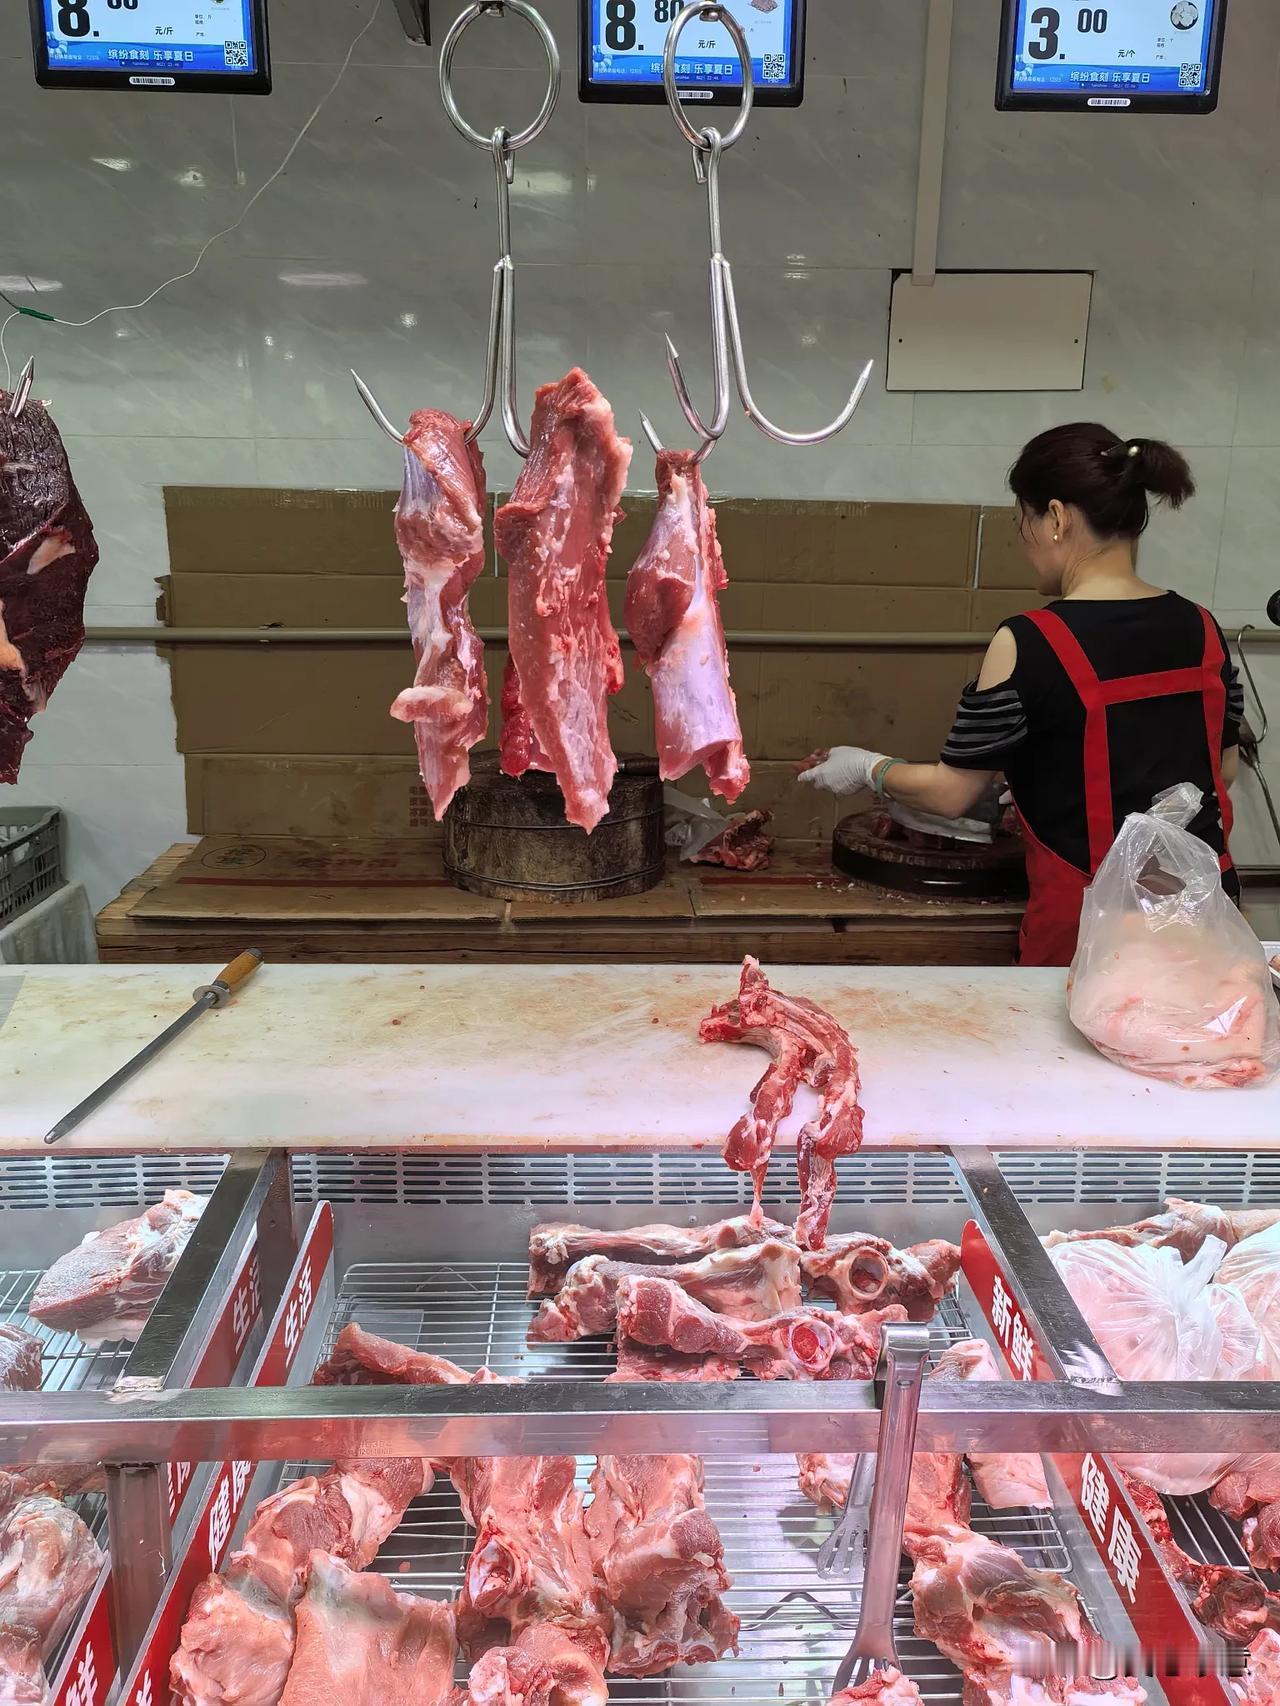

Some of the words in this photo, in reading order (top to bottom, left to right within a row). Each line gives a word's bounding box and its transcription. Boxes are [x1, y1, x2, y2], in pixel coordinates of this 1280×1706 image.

[1077, 8, 1108, 33] 00
[155, 26, 174, 36] 元/斤
[697, 39, 717, 49] 元/斤
[107, 48, 150, 60] 缤纷食刻
[153, 50, 194, 62] 乐享夏日
[1117, 49, 1136, 58] 元/个
[694, 63, 733, 75] 乐享夏日
[1069, 70, 1109, 82] 缤纷食刻
[1112, 72, 1151, 83] 乐享夏日
[284, 1255, 312, 1368] 生活
[991, 1275, 1034, 1381] 新鲜
[1080, 1453, 1142, 1604] 健康
